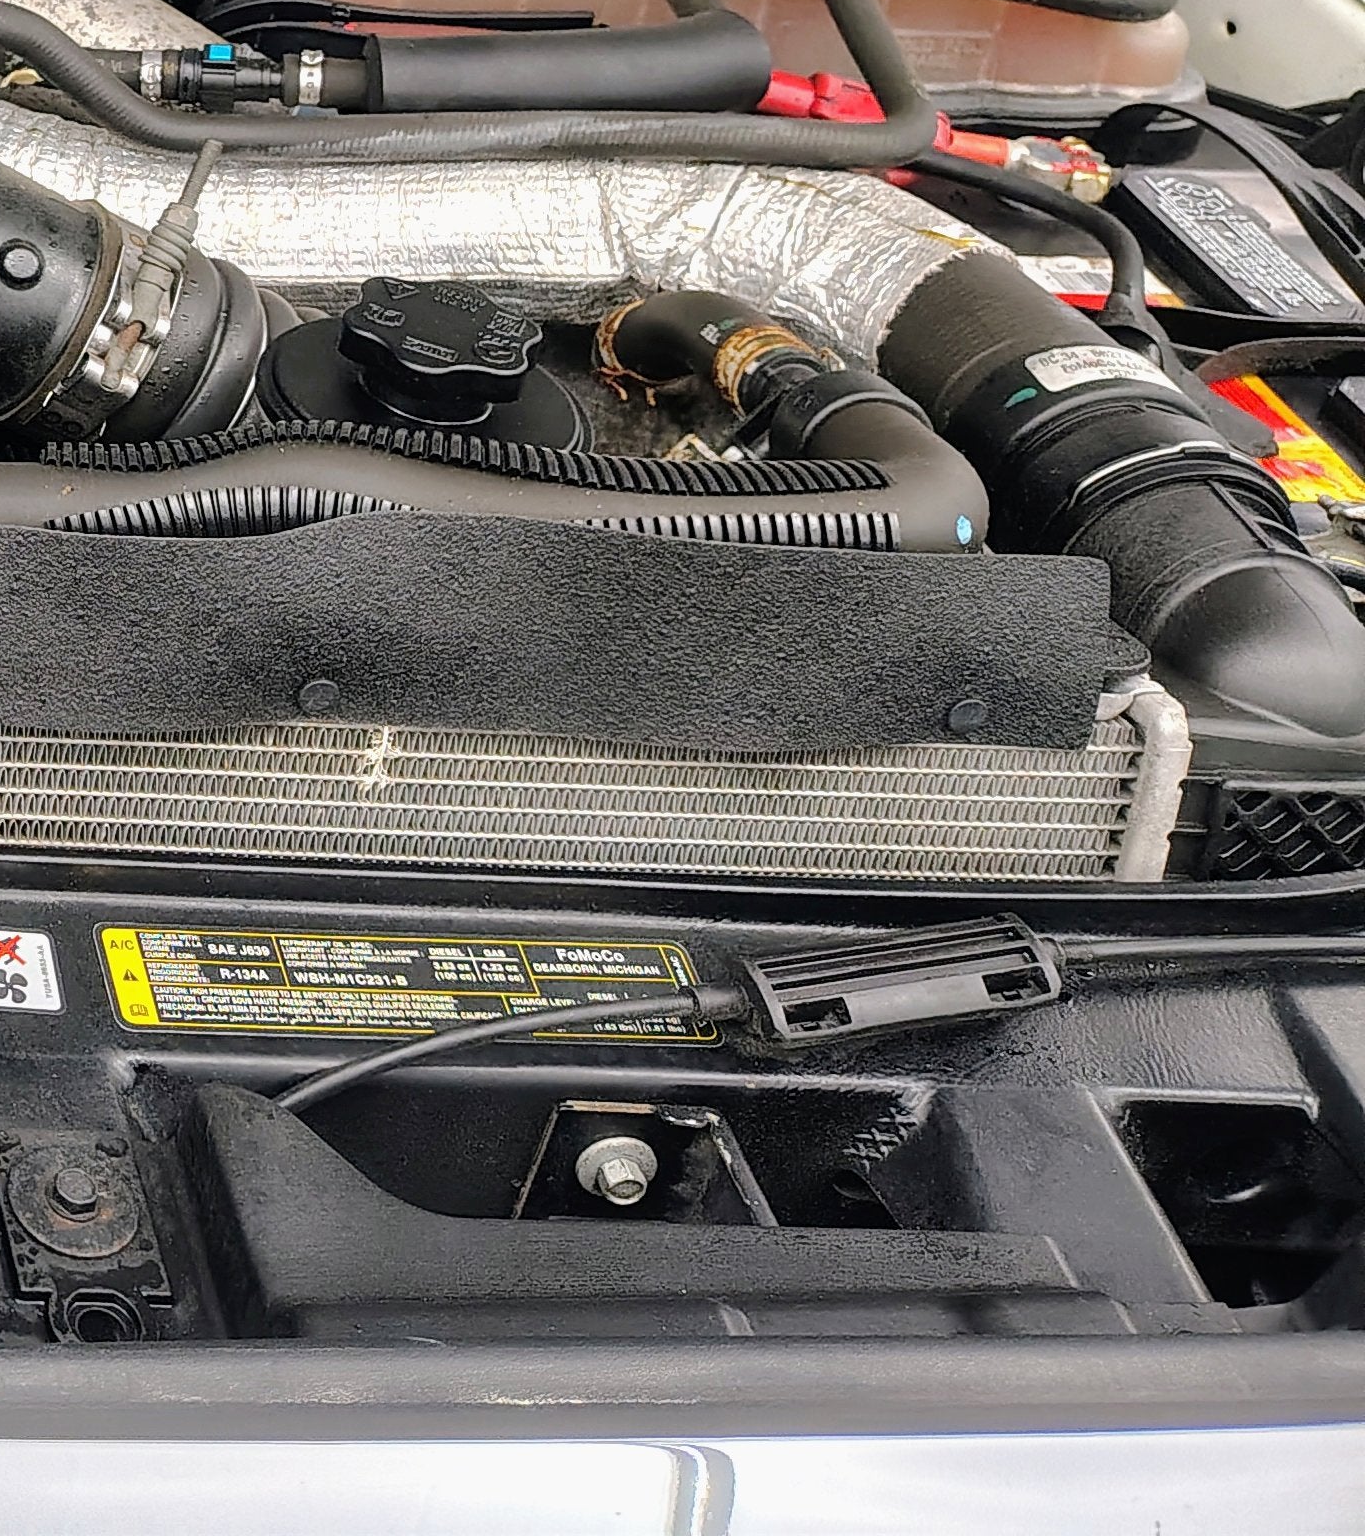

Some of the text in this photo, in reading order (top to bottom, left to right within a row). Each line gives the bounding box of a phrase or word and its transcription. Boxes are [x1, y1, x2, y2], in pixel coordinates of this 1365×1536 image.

[107, 939, 134, 949] A/C
[207, 943, 270, 956] SAE J639
[427, 947, 466, 956] DIESEL
[482, 949, 506, 957] GAS
[554, 947, 626, 962] FoMoCo
[218, 967, 270, 980] R-134A
[532, 962, 661, 975] DEARBORN, MICHIGAN
[293, 971, 408, 986] WSH-M1C231-B
